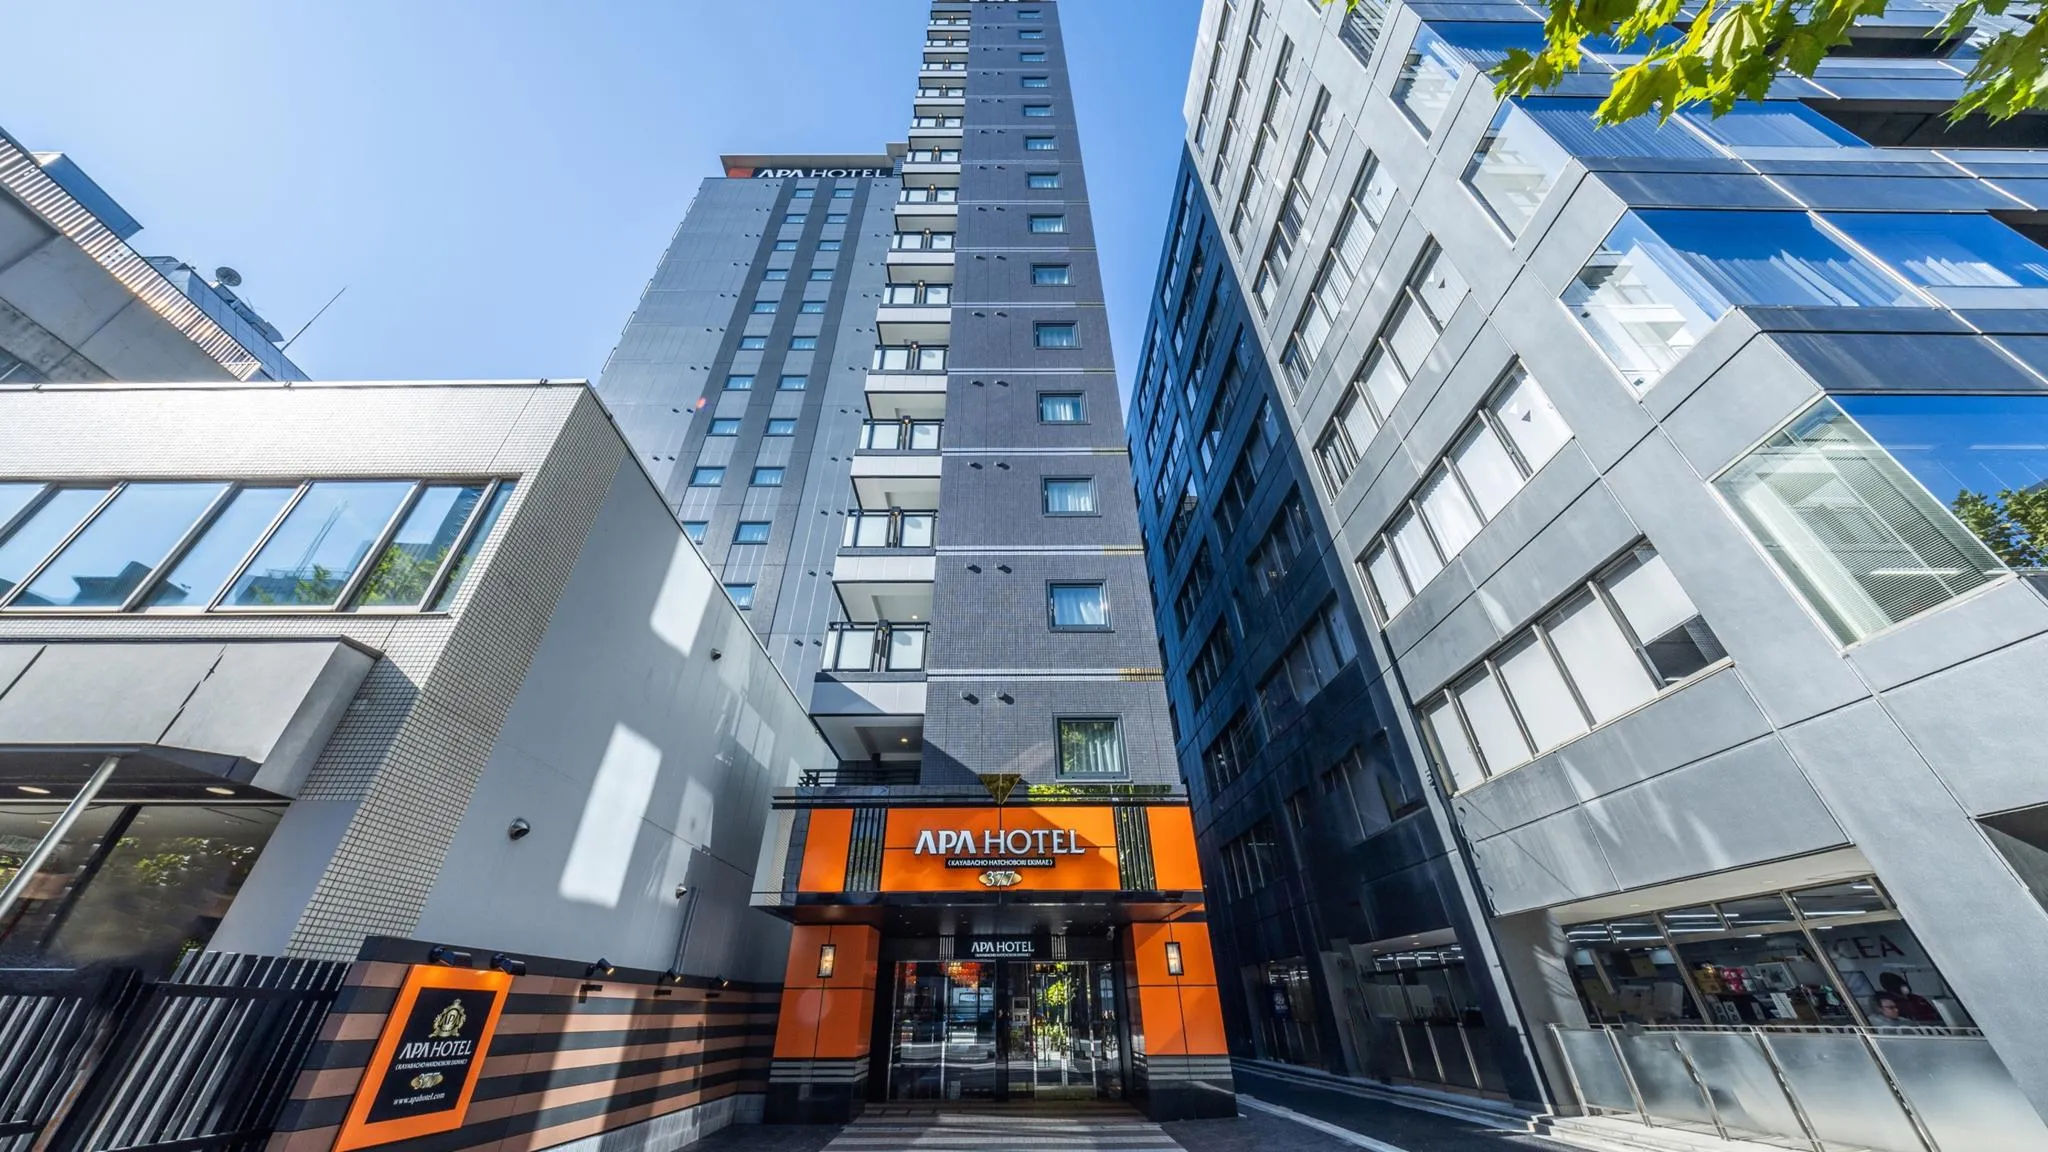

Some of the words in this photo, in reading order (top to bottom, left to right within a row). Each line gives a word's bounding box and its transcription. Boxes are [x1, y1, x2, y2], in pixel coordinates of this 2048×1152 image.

[757, 169, 804, 178] APA
[810, 169, 887, 178] HOTEL
[914, 830, 977, 855] APA
[983, 829, 1086, 855] HOTEL
[985, 871, 1015, 887] 377
[971, 941, 995, 953] APA
[996, 941, 1035, 953] HOTEL
[398, 1042, 430, 1060] APA
[429, 1040, 472, 1058] HOTEL
